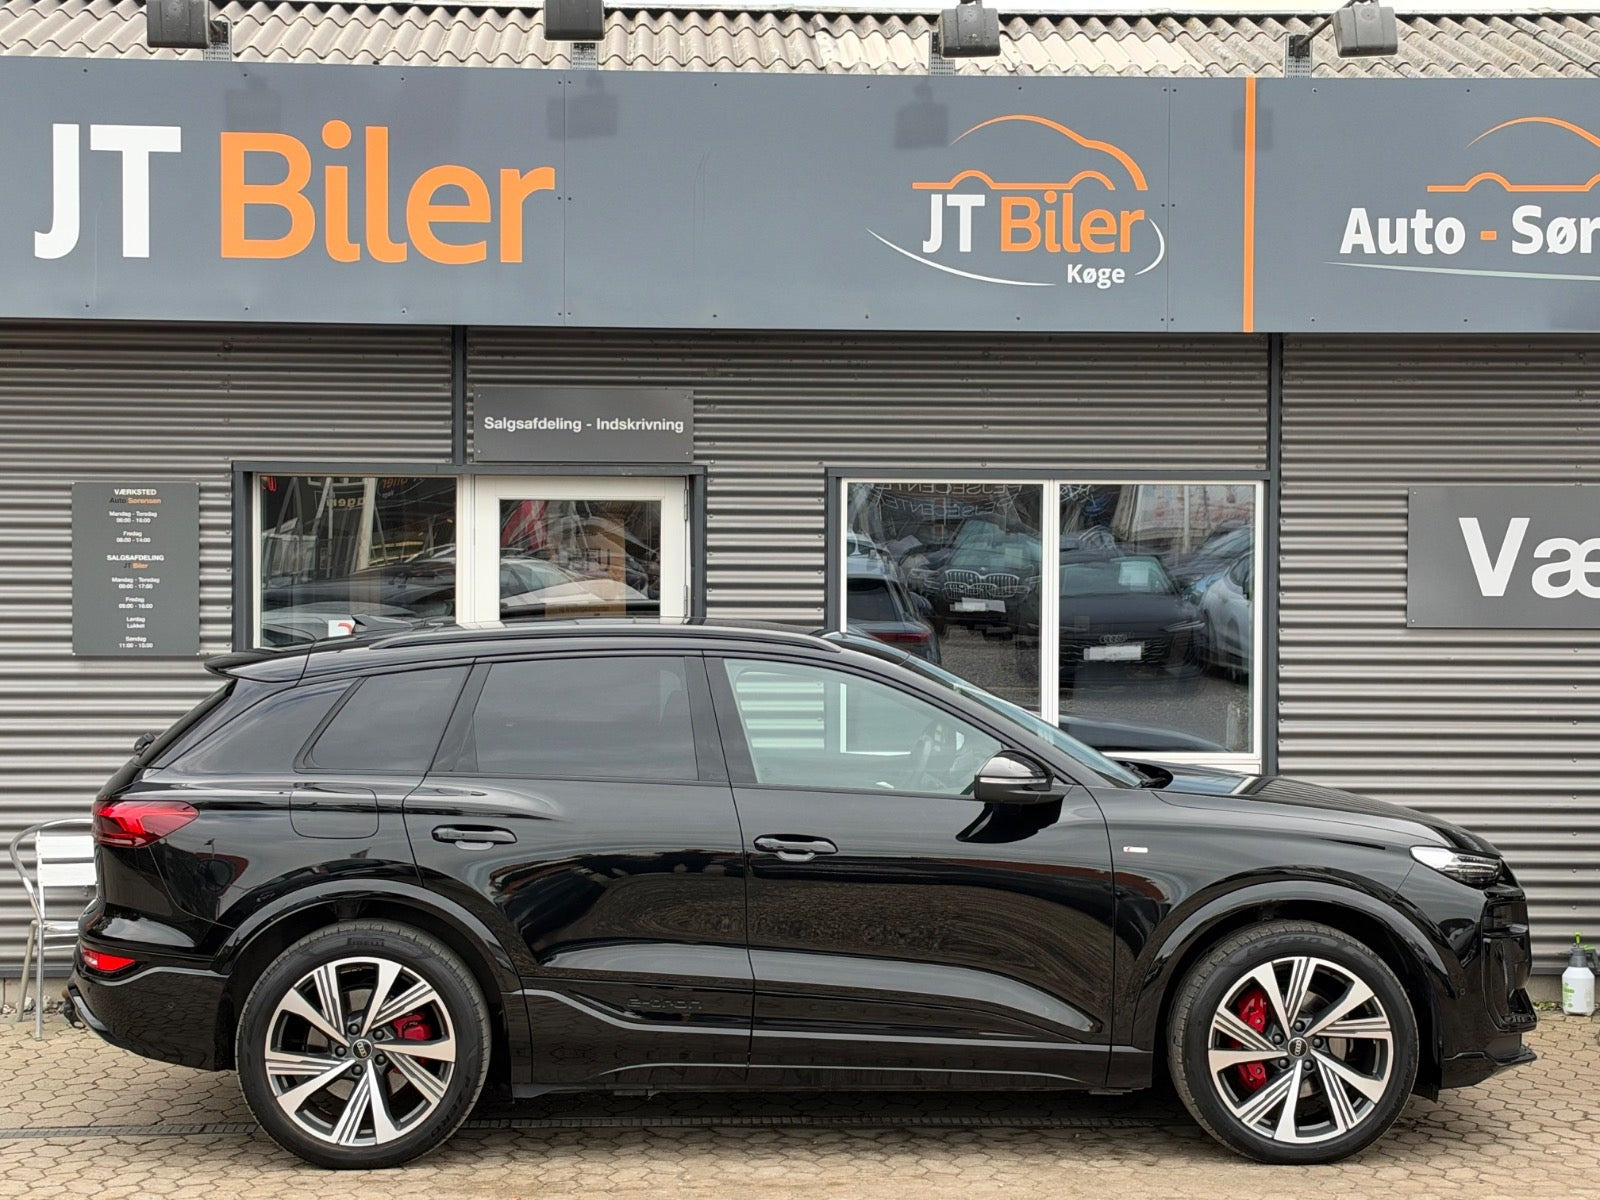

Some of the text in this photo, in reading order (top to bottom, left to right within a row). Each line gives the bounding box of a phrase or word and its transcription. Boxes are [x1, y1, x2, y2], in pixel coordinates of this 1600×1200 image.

[34, 119, 556, 265] JT Biler
[922, 190, 1145, 253] JT Biler
[1339, 207, 1466, 254] Auto
[1479, 230, 1497, 240] -
[1066, 263, 1126, 289] Køge
[484, 416, 582, 433] Salgsafdeling
[596, 417, 684, 433] Indskrivning
[113, 488, 157, 496] VÆRKSTED
